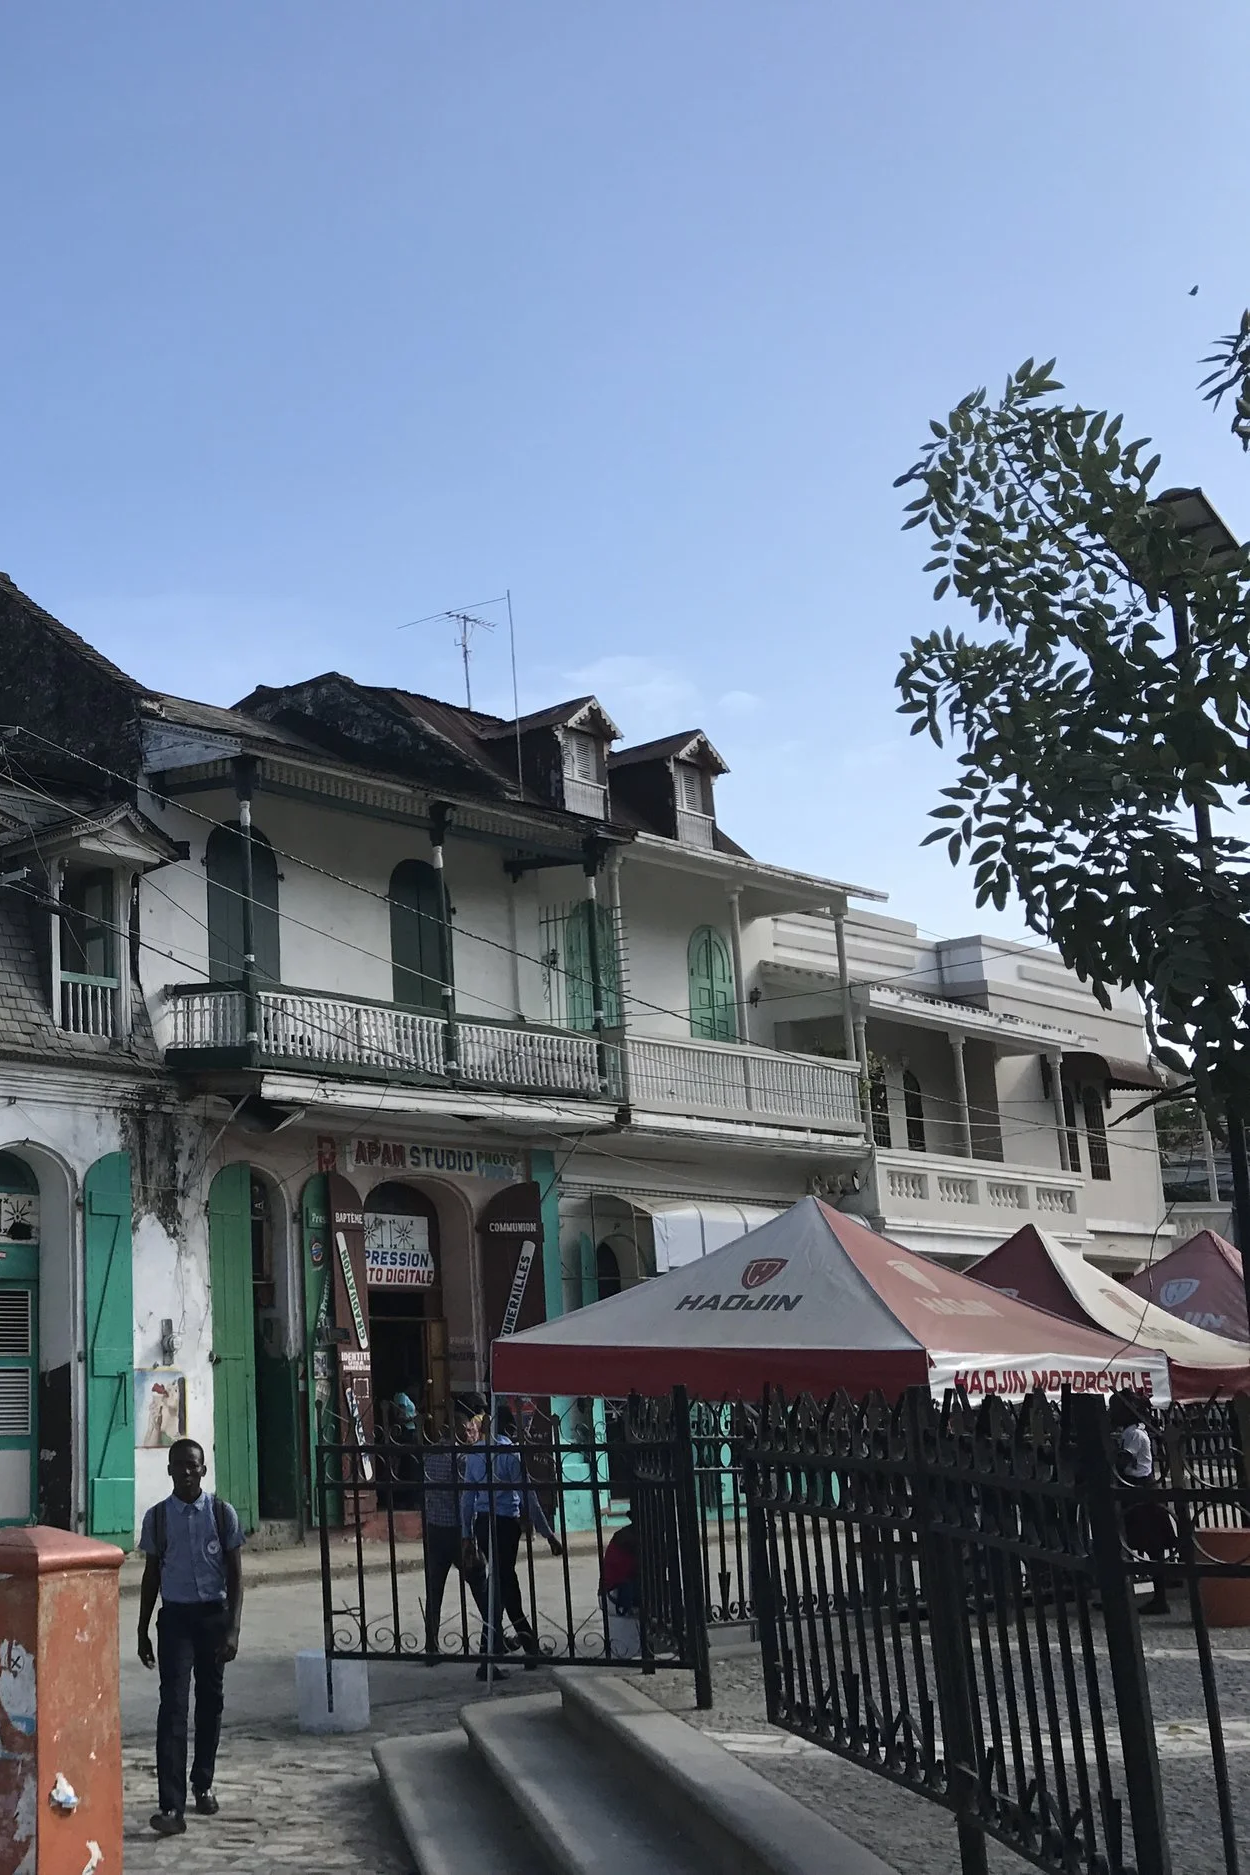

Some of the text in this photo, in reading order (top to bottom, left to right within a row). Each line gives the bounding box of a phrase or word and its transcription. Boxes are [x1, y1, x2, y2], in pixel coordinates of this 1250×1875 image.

[409, 1146, 473, 1172] STUDIO
[489, 1222, 537, 1232] COMMUNION
[386, 1268, 434, 1284] DIGITALE
[341, 1250, 366, 1340] GRADUATION
[674, 1294, 804, 1311] HAOJIN
[954, 1370, 1153, 1394] HAOJIN MOTORCYCLE
